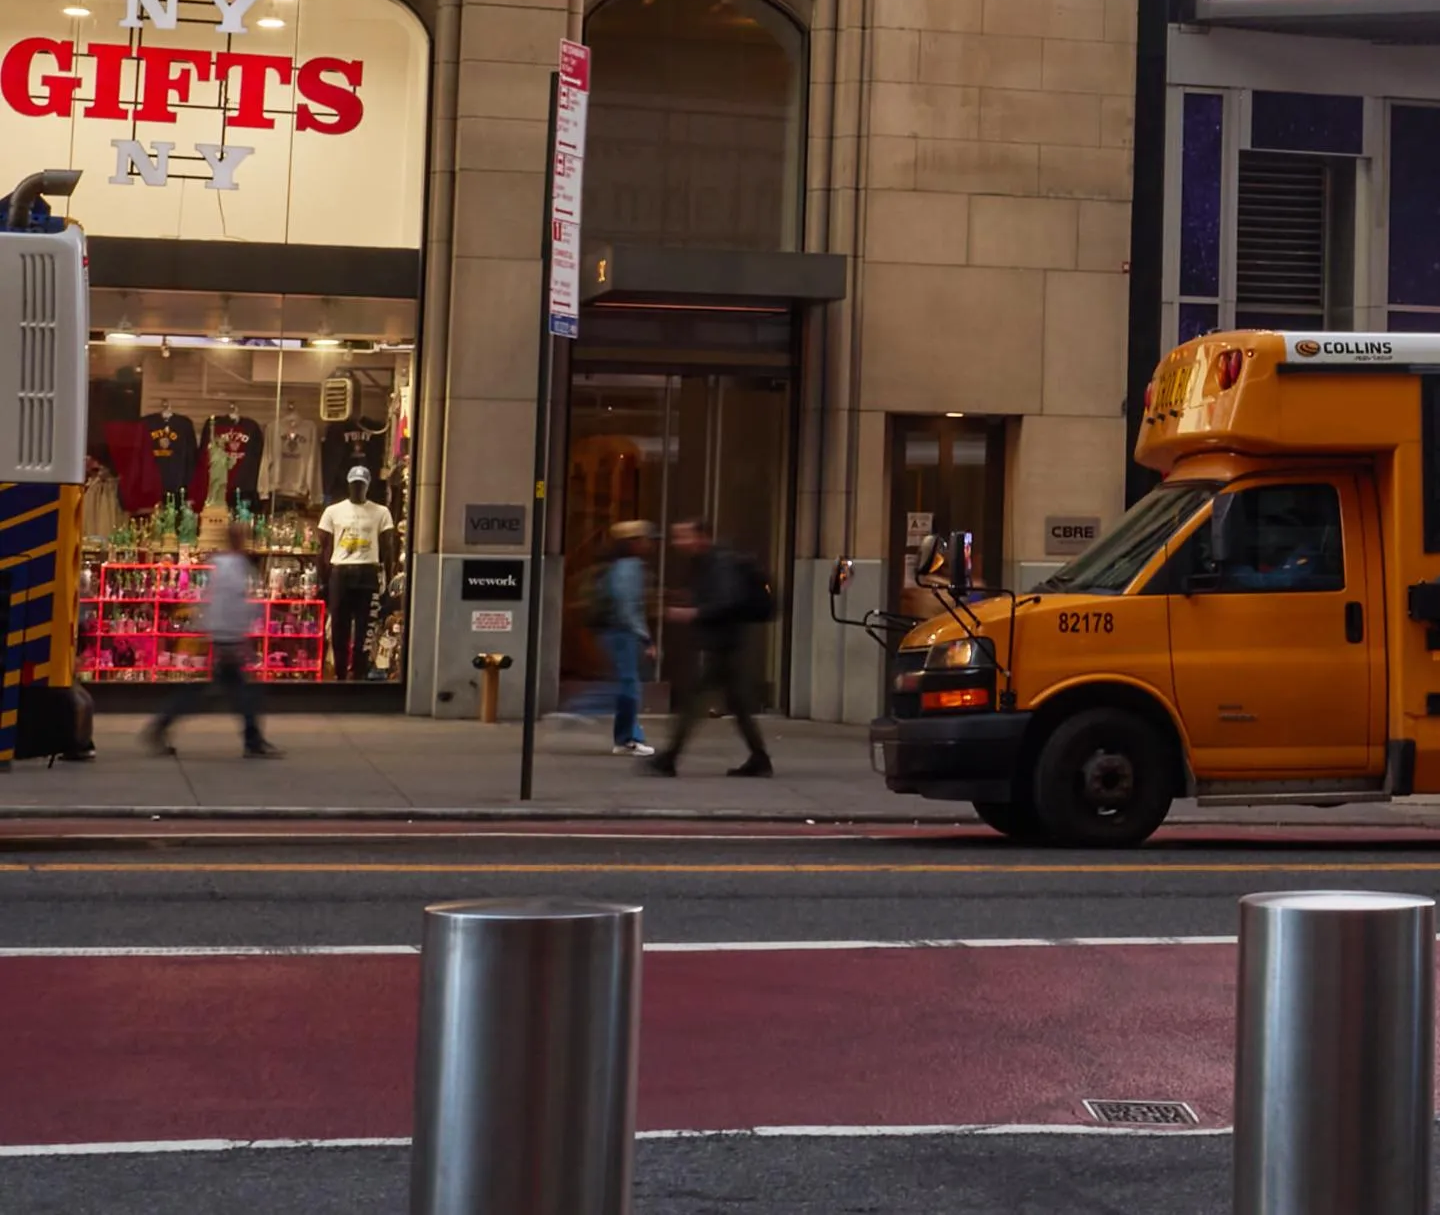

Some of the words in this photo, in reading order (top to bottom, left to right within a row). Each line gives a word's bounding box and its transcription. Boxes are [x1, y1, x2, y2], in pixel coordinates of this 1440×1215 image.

[1, 37, 364, 135] GIFTS
[1323, 342, 1392, 354] COLLINS
[470, 517, 521, 532] vanke
[1051, 526, 1095, 539] CBRE
[468, 574, 517, 587] wework
[1058, 612, 1114, 633] 82178
